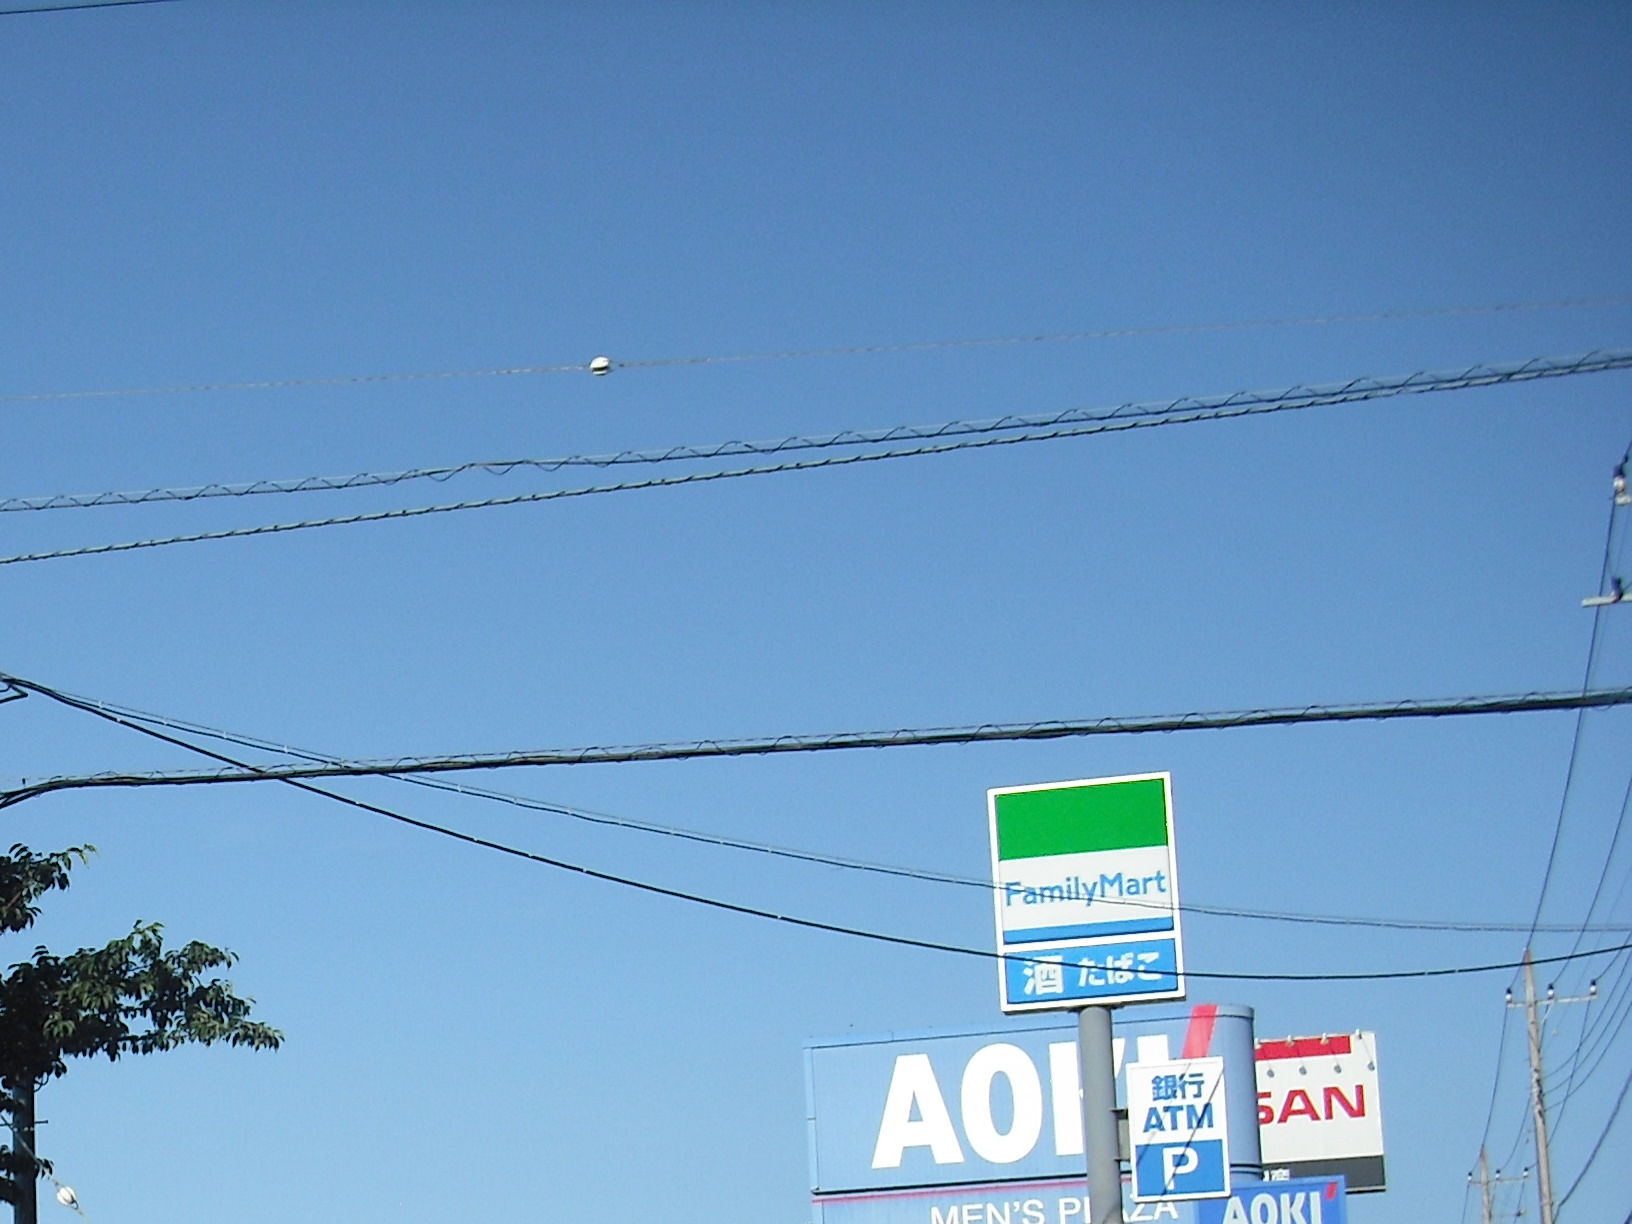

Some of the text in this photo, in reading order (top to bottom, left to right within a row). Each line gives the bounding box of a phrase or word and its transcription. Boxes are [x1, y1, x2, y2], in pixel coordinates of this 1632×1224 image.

[1005, 870, 1167, 907] FamilyMart
[1022, 952, 1163, 995] 酒 たばこ
[871, 1034, 1169, 1169] AOK
[1152, 1073, 1205, 1101] 銀行
[1143, 1103, 1214, 1132] ATM
[1162, 1146, 1199, 1190] P
[1059, 1194, 1179, 1224] PLZA
